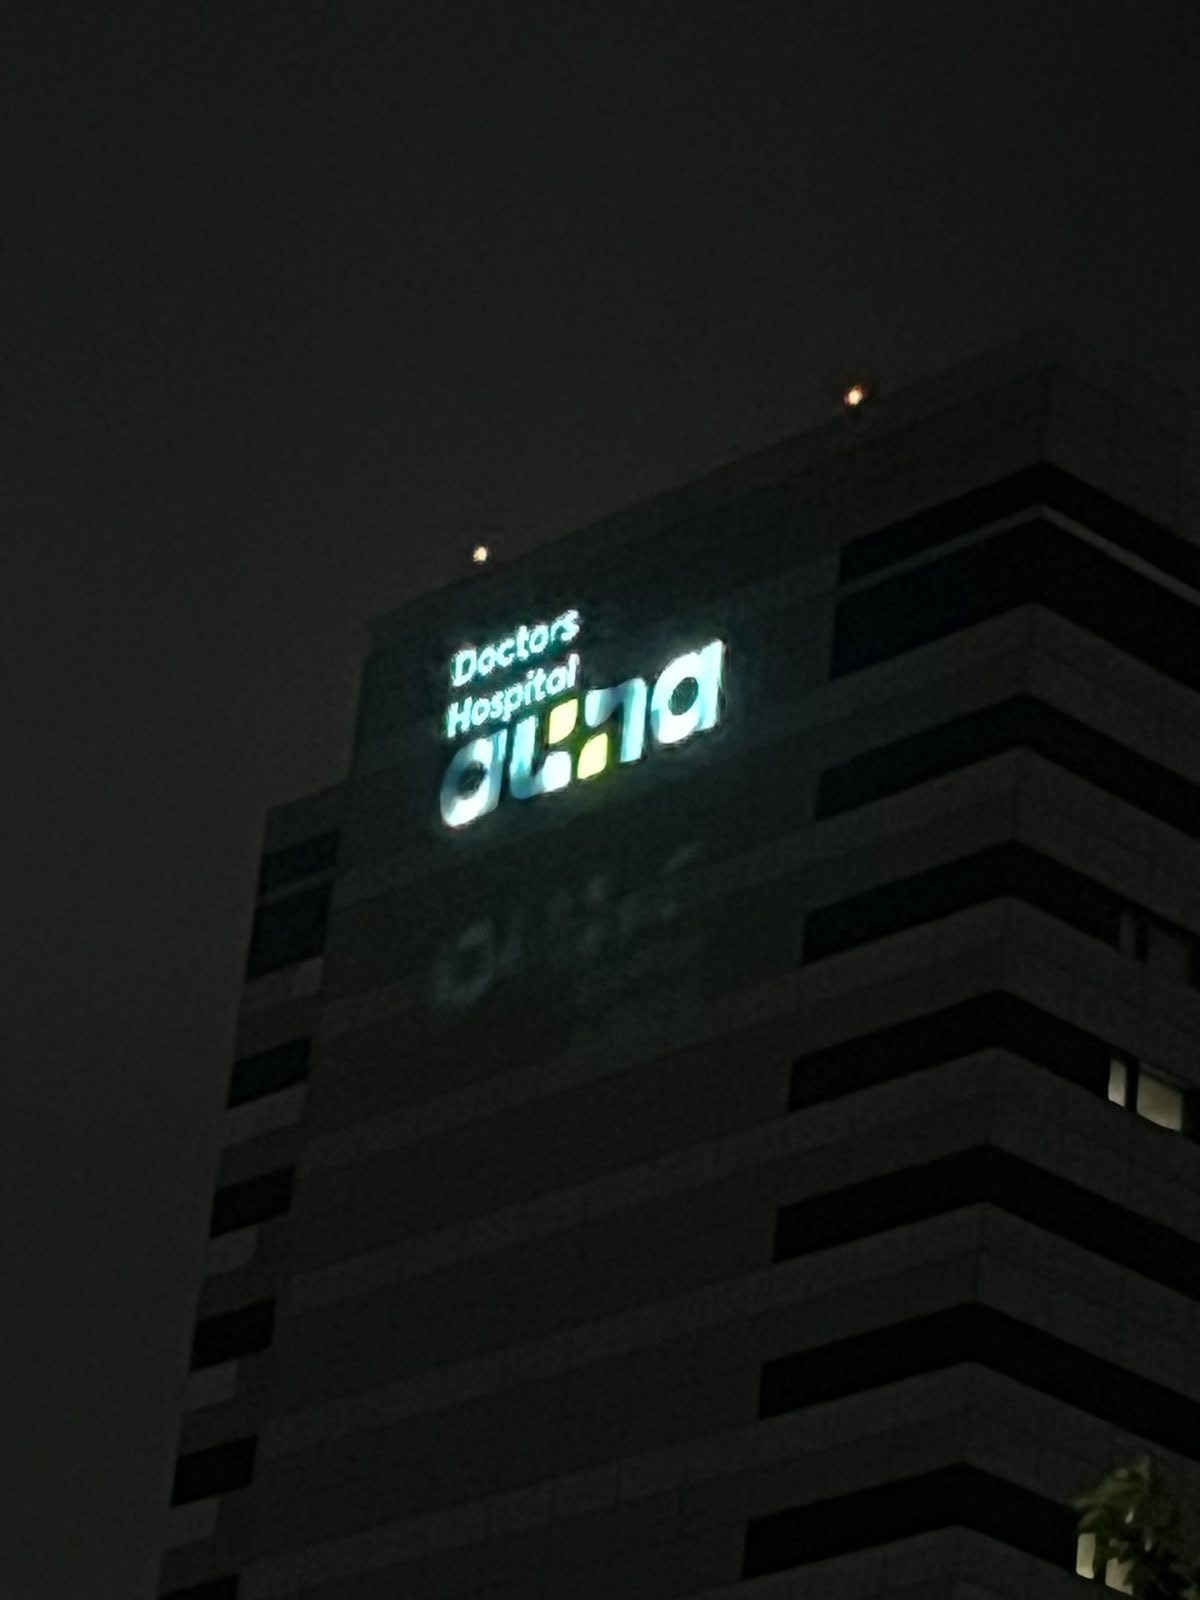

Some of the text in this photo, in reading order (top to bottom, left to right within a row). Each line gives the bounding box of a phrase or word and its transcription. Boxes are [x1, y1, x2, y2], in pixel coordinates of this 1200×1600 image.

[451, 609, 580, 687] Doctors
[440, 638, 724, 828] auna
[446, 653, 580, 738] Hospital
